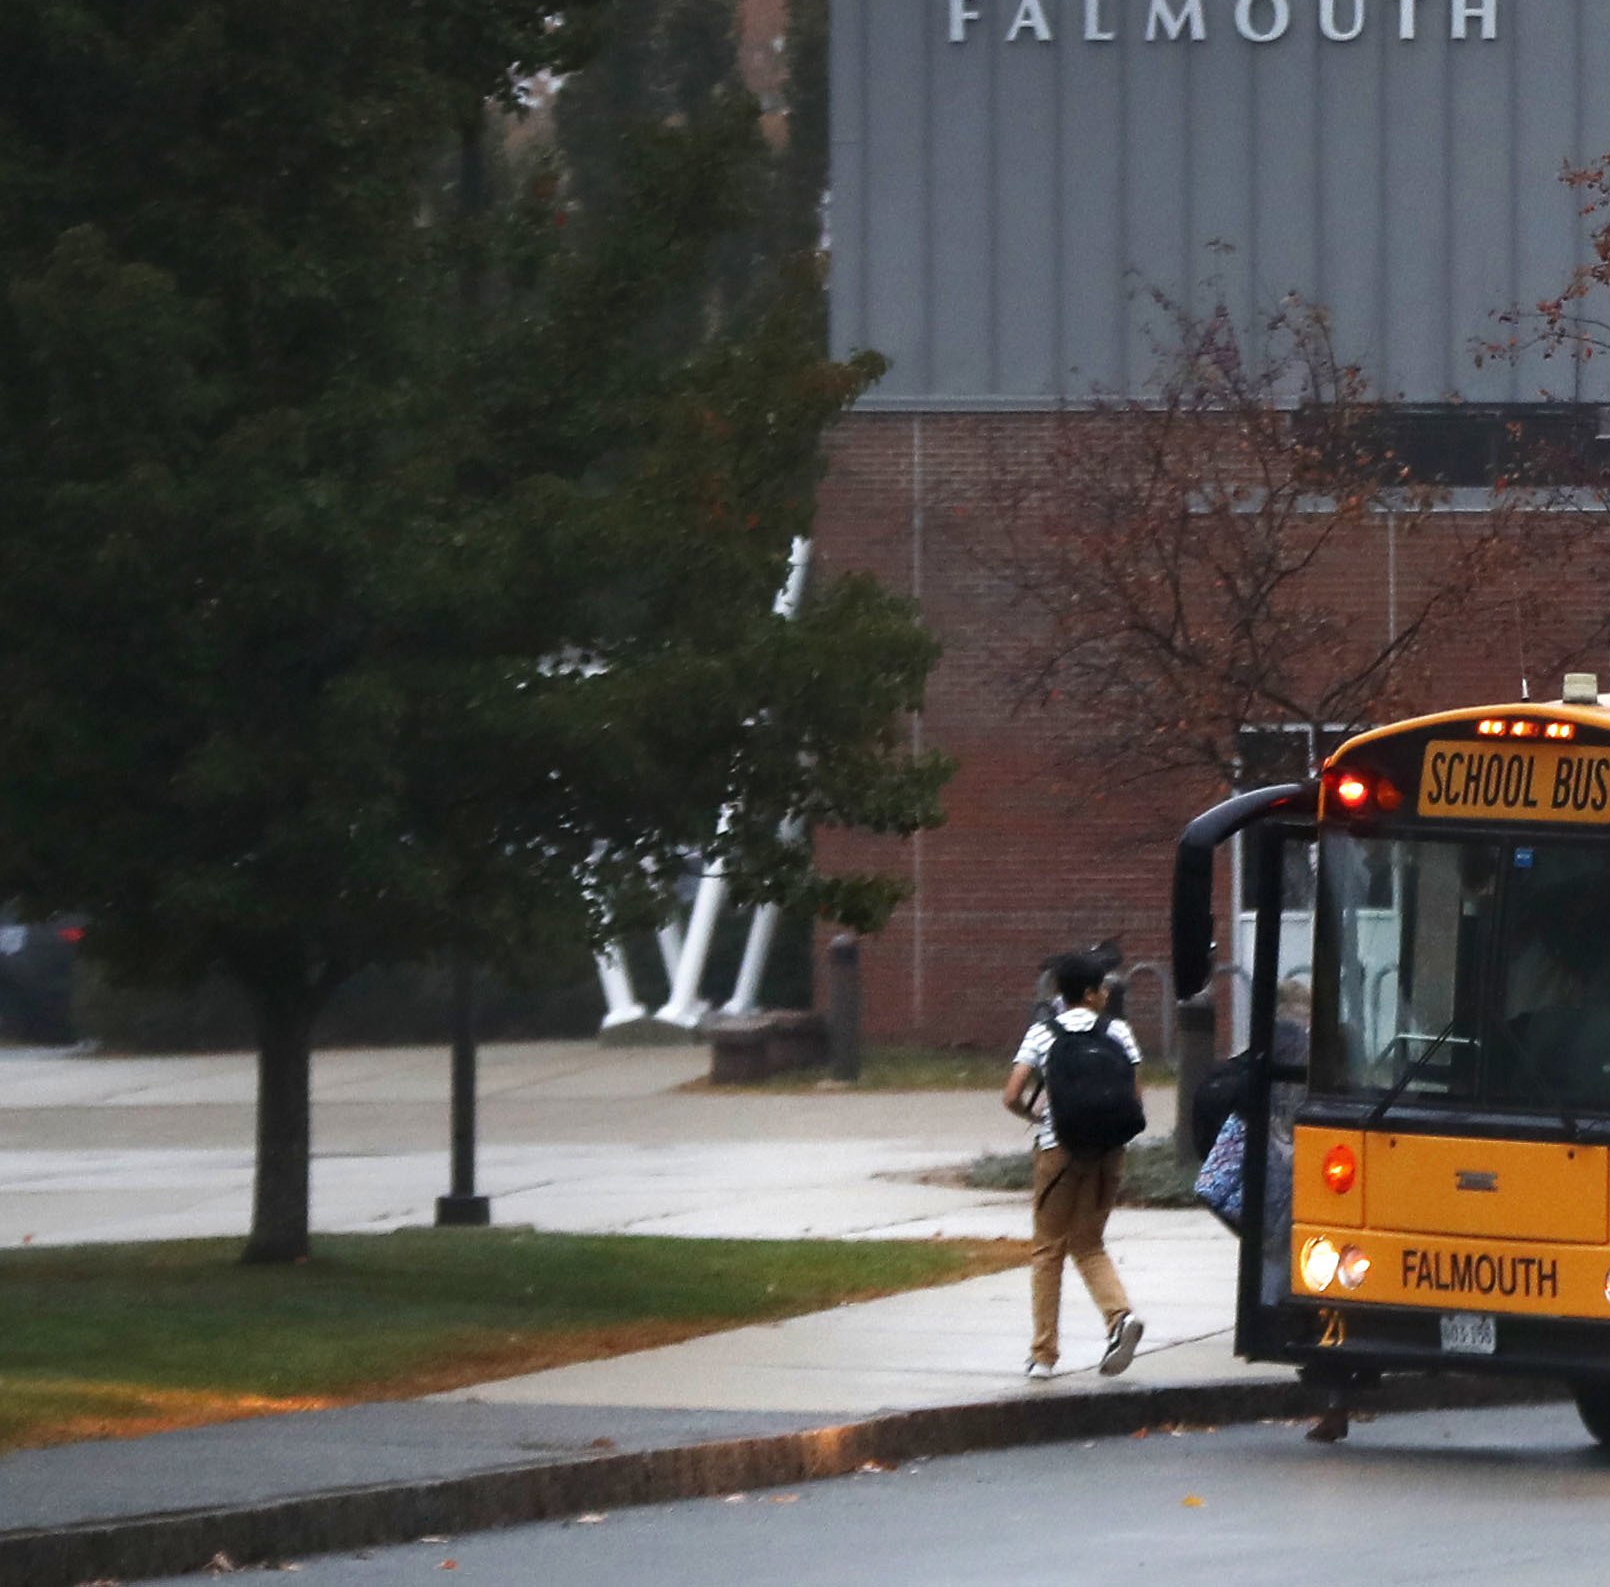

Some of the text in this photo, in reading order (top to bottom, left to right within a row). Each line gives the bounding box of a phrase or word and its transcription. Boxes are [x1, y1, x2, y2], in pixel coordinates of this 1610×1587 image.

[1427, 751, 1610, 812] SCHOOL BUS
[1402, 1249, 1558, 1298] FALMOUTH
[1317, 1308, 1346, 1347] 21
